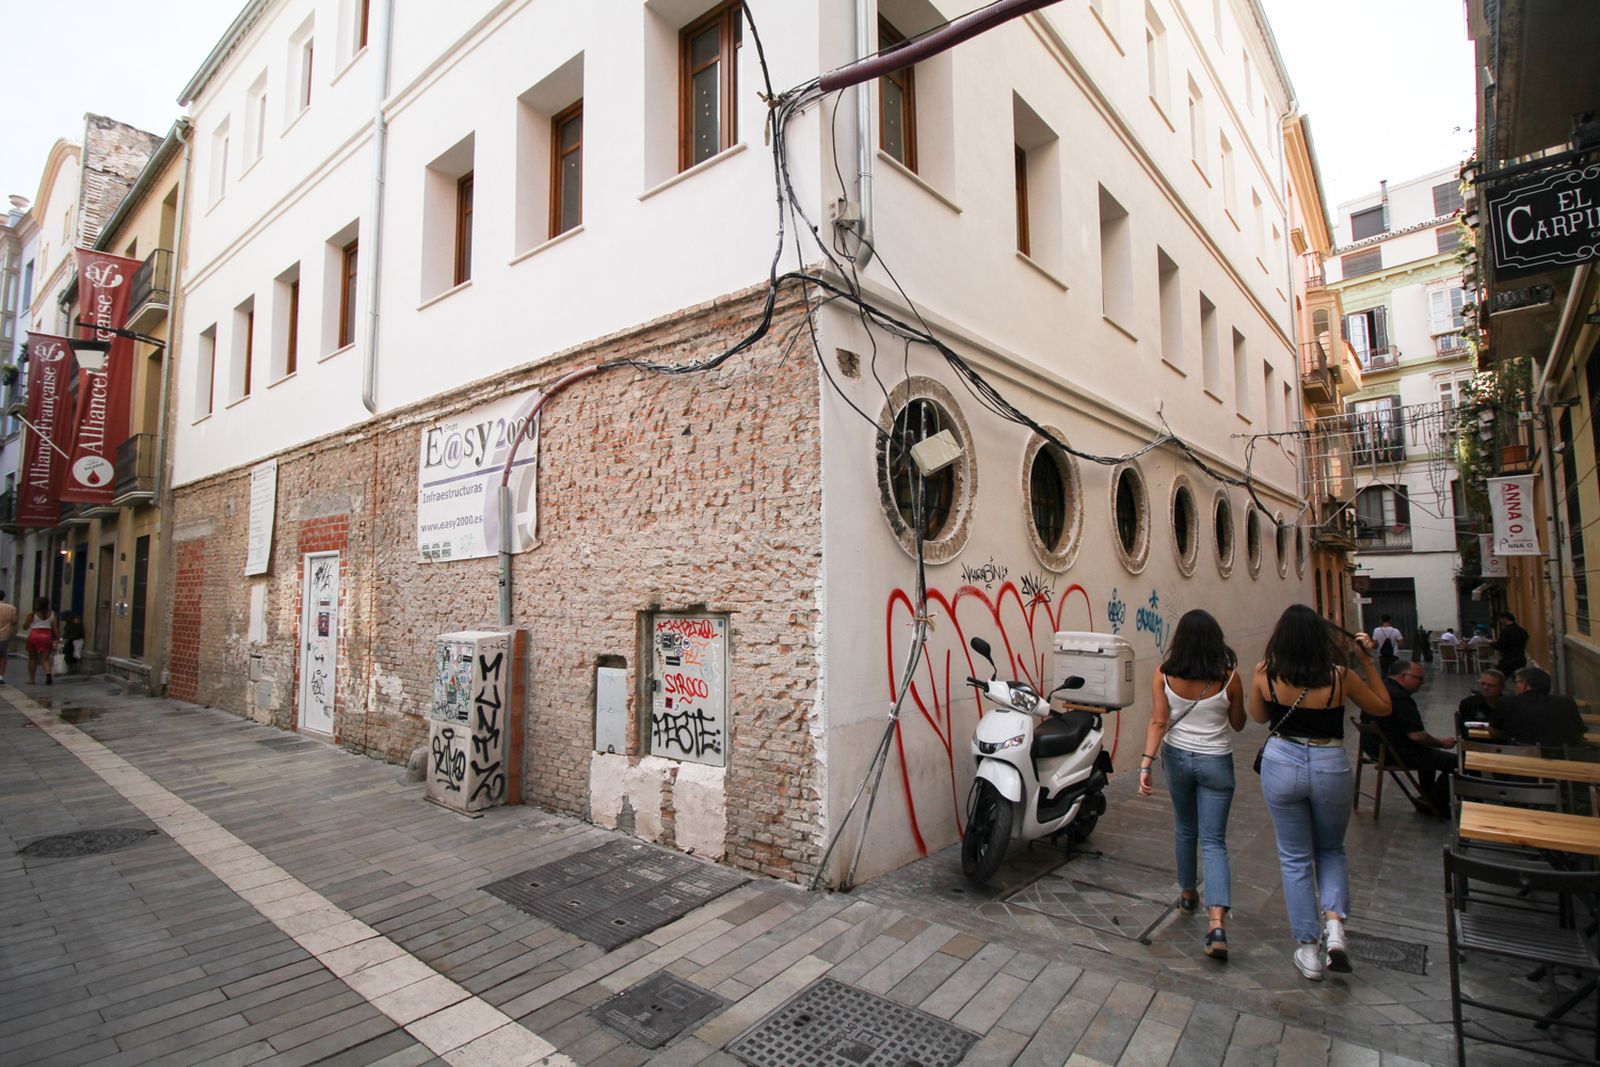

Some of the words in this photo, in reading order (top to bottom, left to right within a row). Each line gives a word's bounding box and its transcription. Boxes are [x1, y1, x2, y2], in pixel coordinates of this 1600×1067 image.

[1558, 188, 1592, 212] EL
[422, 483, 483, 504] Infraestructuras
[1504, 483, 1522, 520] ANNA
[421, 514, 483, 532] www.easy2000.es
